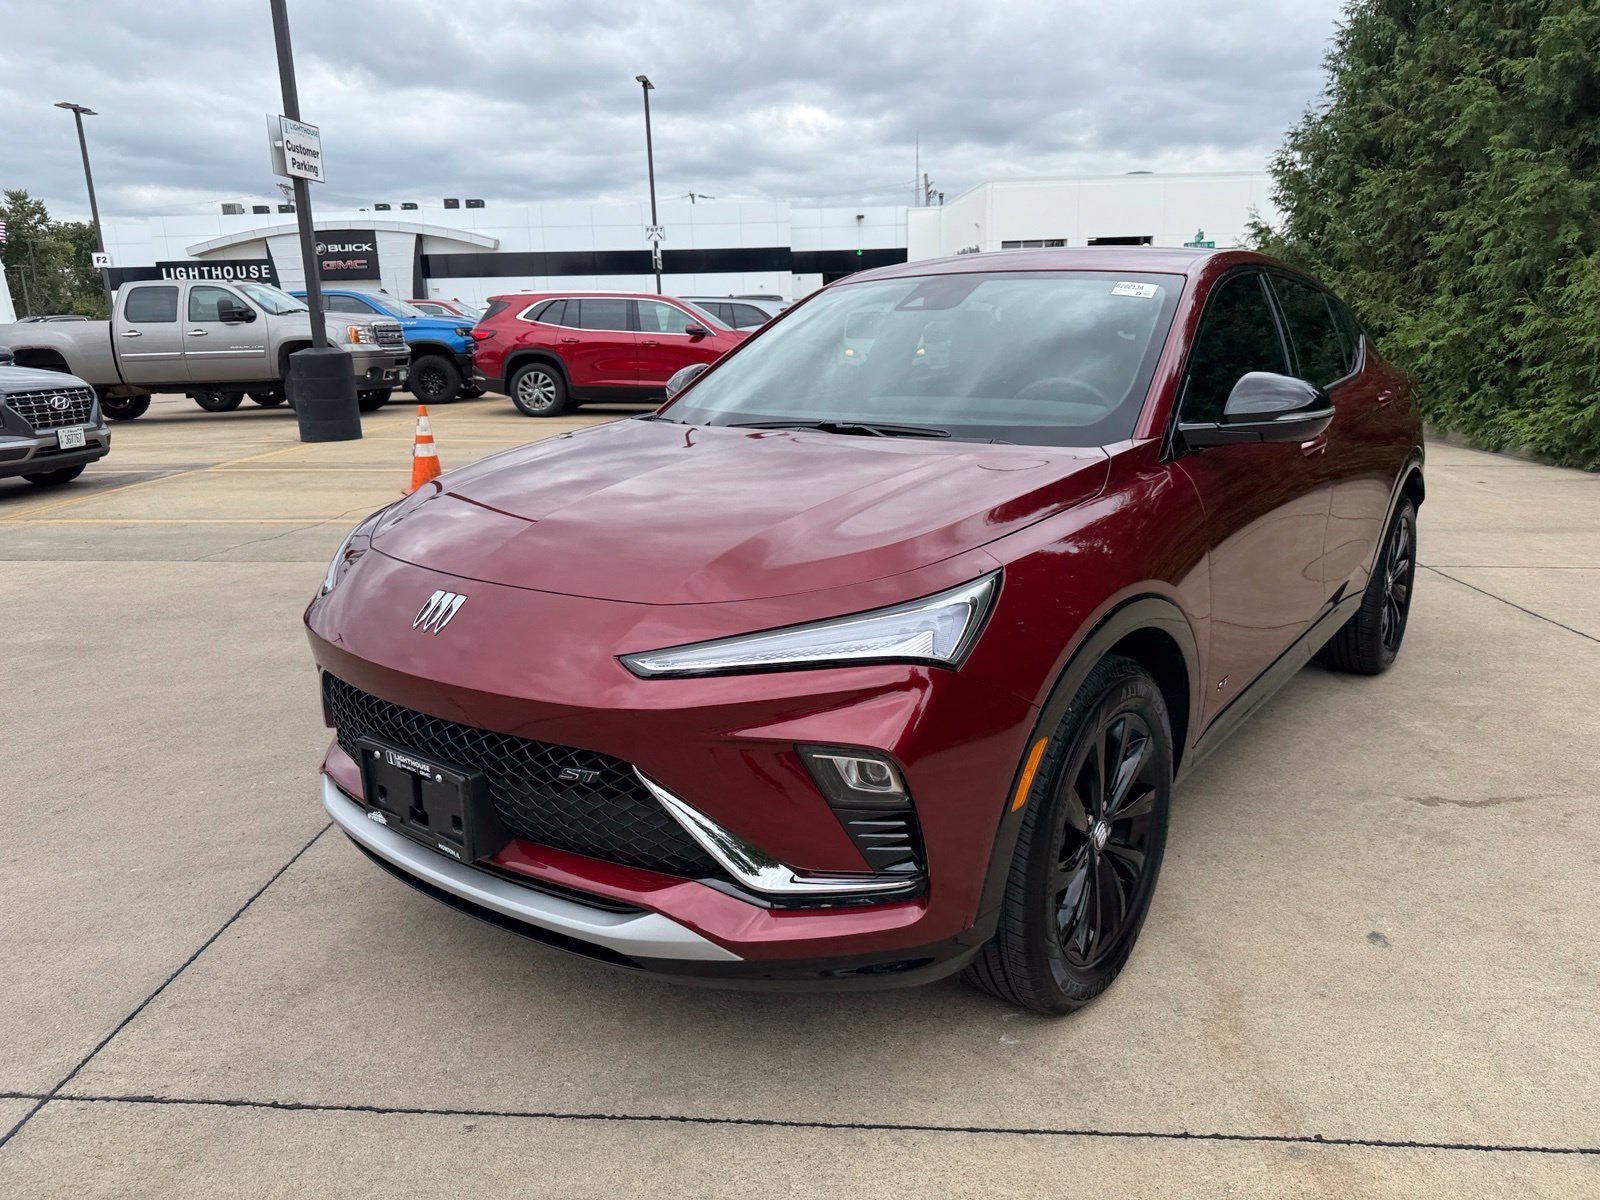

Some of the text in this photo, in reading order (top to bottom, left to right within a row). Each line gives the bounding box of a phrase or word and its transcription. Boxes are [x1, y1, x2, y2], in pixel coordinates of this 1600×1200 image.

[289, 121, 319, 137] LIGHTHOUSE
[286, 140, 319, 159] Customer
[291, 157, 318, 177] Parking
[327, 243, 373, 252] BUICK
[96, 256, 108, 264] F2
[322, 260, 368, 270] GMC
[162, 265, 271, 281] LIGHTHOUSE
[394, 753, 431, 773] LIGHTHOUSE
[557, 767, 600, 783] ST
